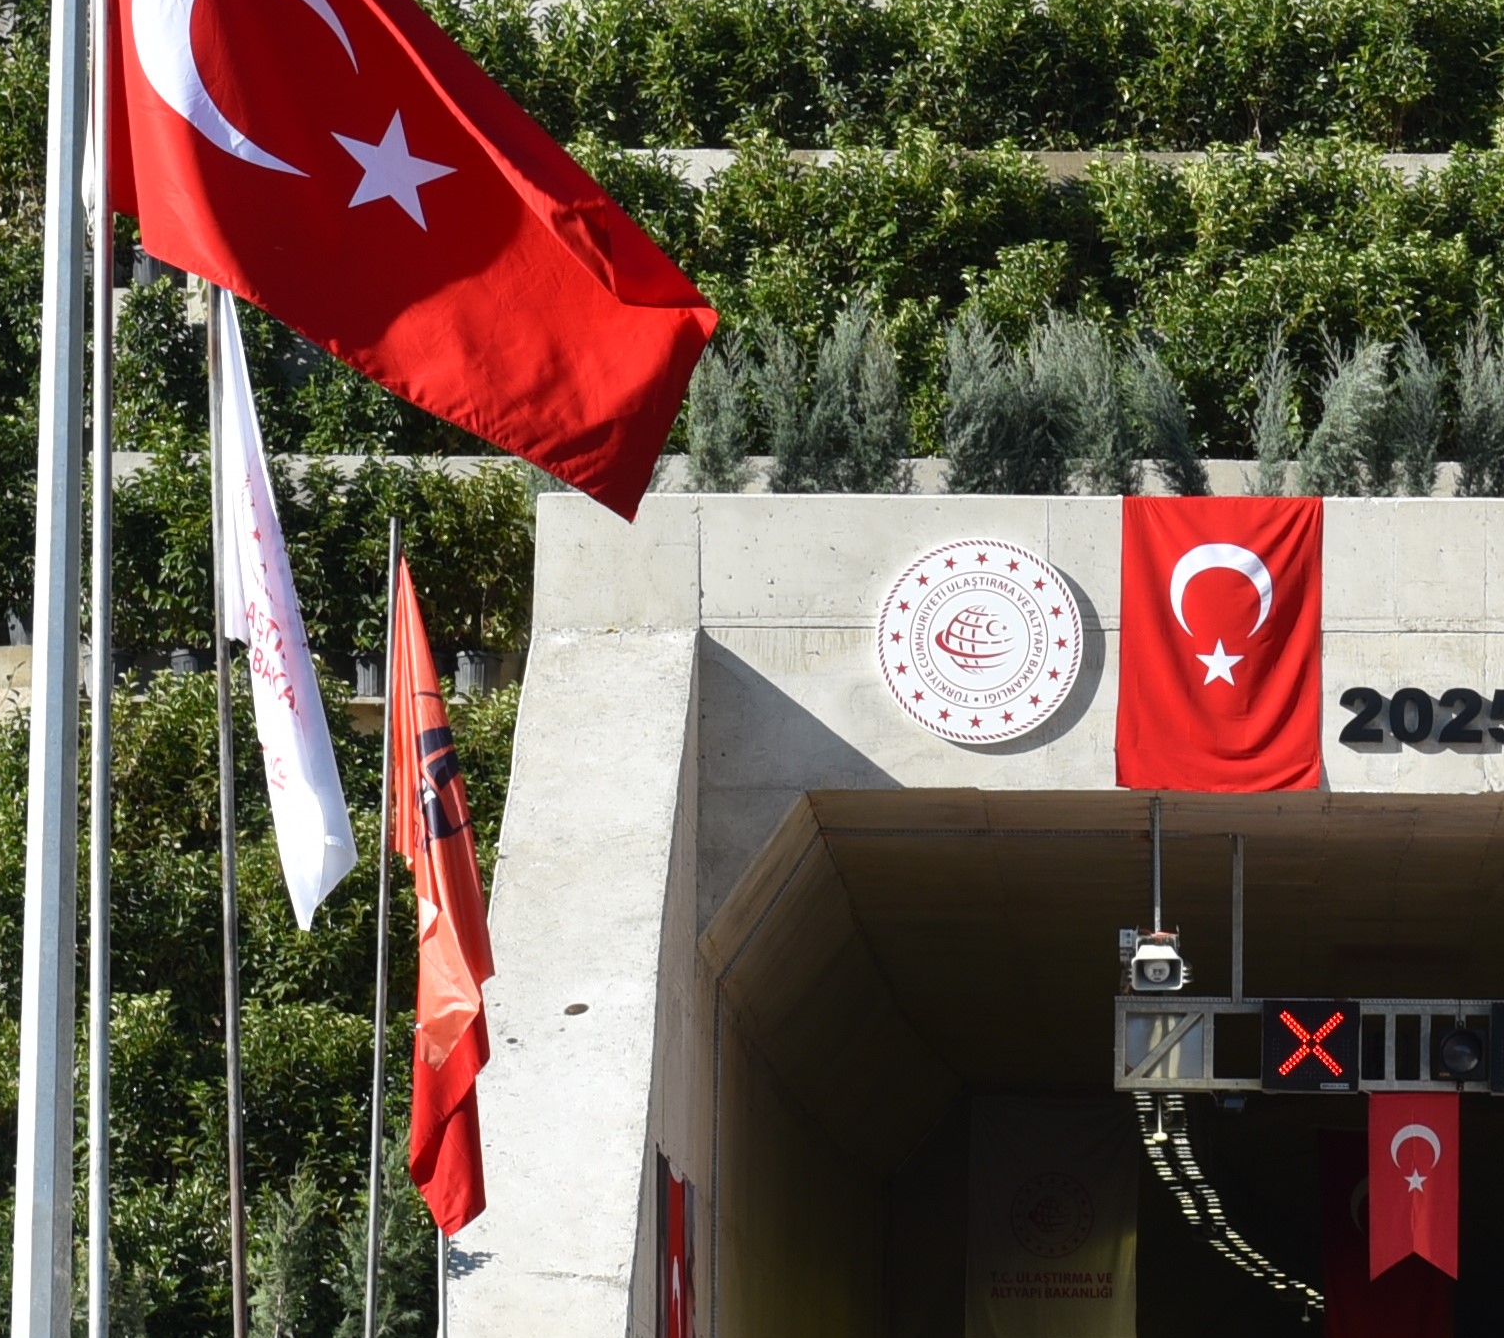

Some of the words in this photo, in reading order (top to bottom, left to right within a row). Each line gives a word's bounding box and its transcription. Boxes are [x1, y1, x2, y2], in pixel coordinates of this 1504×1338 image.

[947, 576, 1015, 597] ULAŞTIRMA
[1017, 593, 1031, 609] VE
[915, 588, 946, 669] CUMHURİYETİ
[1026, 609, 1043, 658] ALTYAPI
[924, 668, 970, 703] TÜRKİYE
[984, 659, 1039, 704] BAKANLIĞI
[990, 1272, 1012, 1284] T.C.
[1015, 1272, 1093, 1286] ULAŞTIRMA
[1097, 1272, 1113, 1284] VE
[991, 1287, 1042, 1299] ALTYAPI
[1045, 1286, 1113, 1299] BAKANLIĞI
